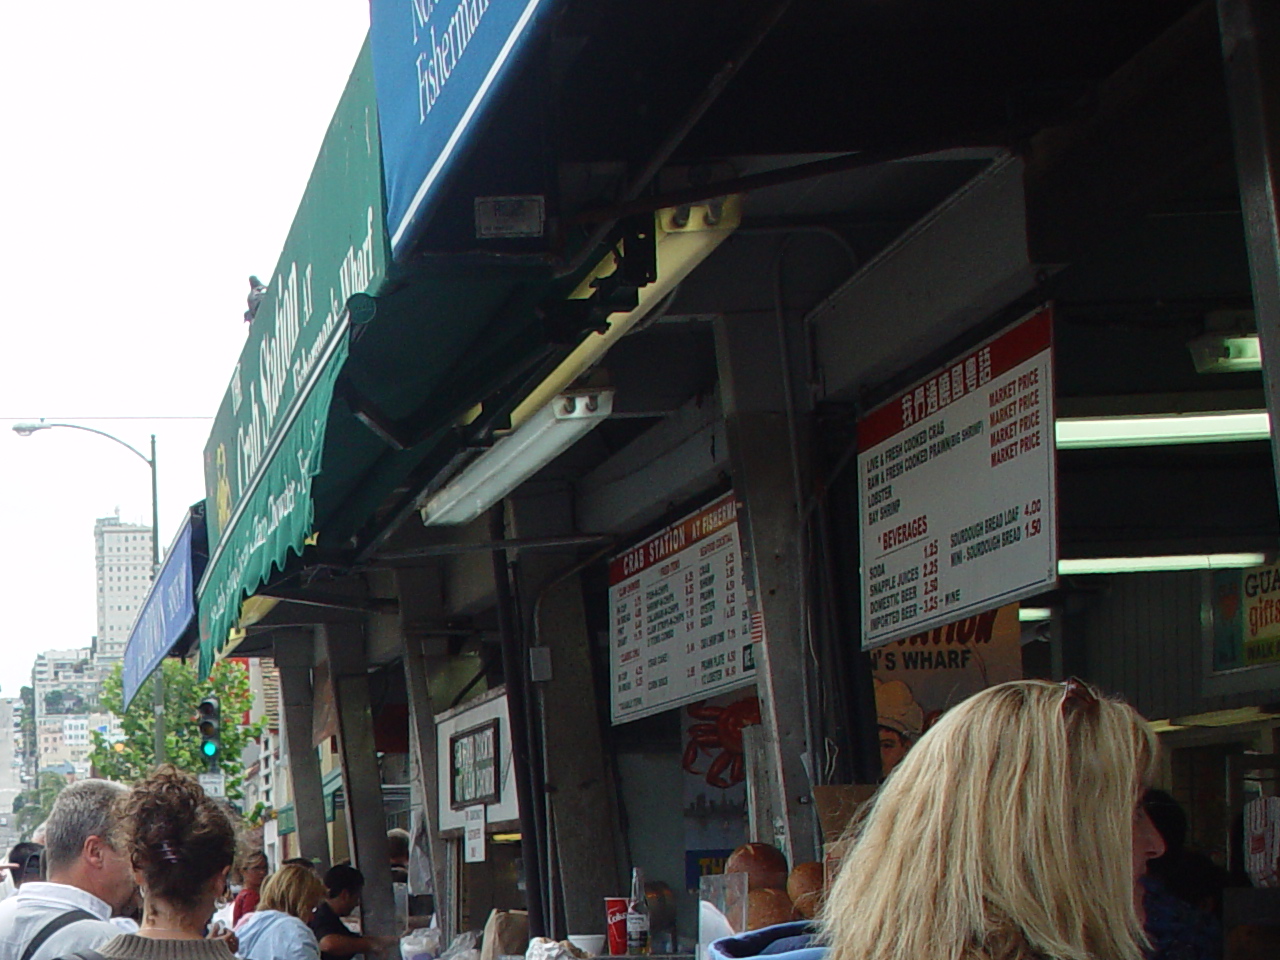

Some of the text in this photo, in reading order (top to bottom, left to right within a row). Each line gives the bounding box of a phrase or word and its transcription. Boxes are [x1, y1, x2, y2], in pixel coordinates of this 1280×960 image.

[339, 205, 375, 305] Wharf
[238, 380, 262, 497] Crab
[259, 261, 300, 448] Station
[989, 367, 1039, 408] MARKET PRICE
[989, 388, 1040, 428] MARKET PRICE
[867, 455, 879, 474] LIVE
[885, 442, 903, 464] FRESH
[904, 430, 927, 454] COOKED
[928, 419, 945, 441] CRAB
[990, 409, 1040, 449] MARKET PRICE
[991, 430, 1041, 468] MARKET PRICE
[868, 473, 879, 491] RAW
[885, 458, 903, 480] FRESH
[904, 448, 928, 471] COOKED
[868, 484, 893, 509] LOBSTER
[869, 498, 901, 526] BAY SHRIMP
[623, 499, 737, 576] CRAB STATION AT FISHERMA
[882, 514, 928, 551] BEVERAGES
[950, 499, 1041, 549] SOURDOUGH BREAD LOAF 4.00
[966, 536, 1001, 562] SOURDOUGH
[1002, 526, 1021, 548] BREAD
[1024, 518, 1041, 539] 1.50
[869, 539, 938, 581] SODA 1.25
[870, 559, 938, 597] SNAPPLE JUICES 2.25
[870, 577, 938, 615] DOMESTIC BEER 2.50
[870, 609, 900, 632] IMPORTED
[901, 603, 918, 622] BEER
[945, 589, 961, 607] WINE
[902, 648, 973, 671] WHARF
